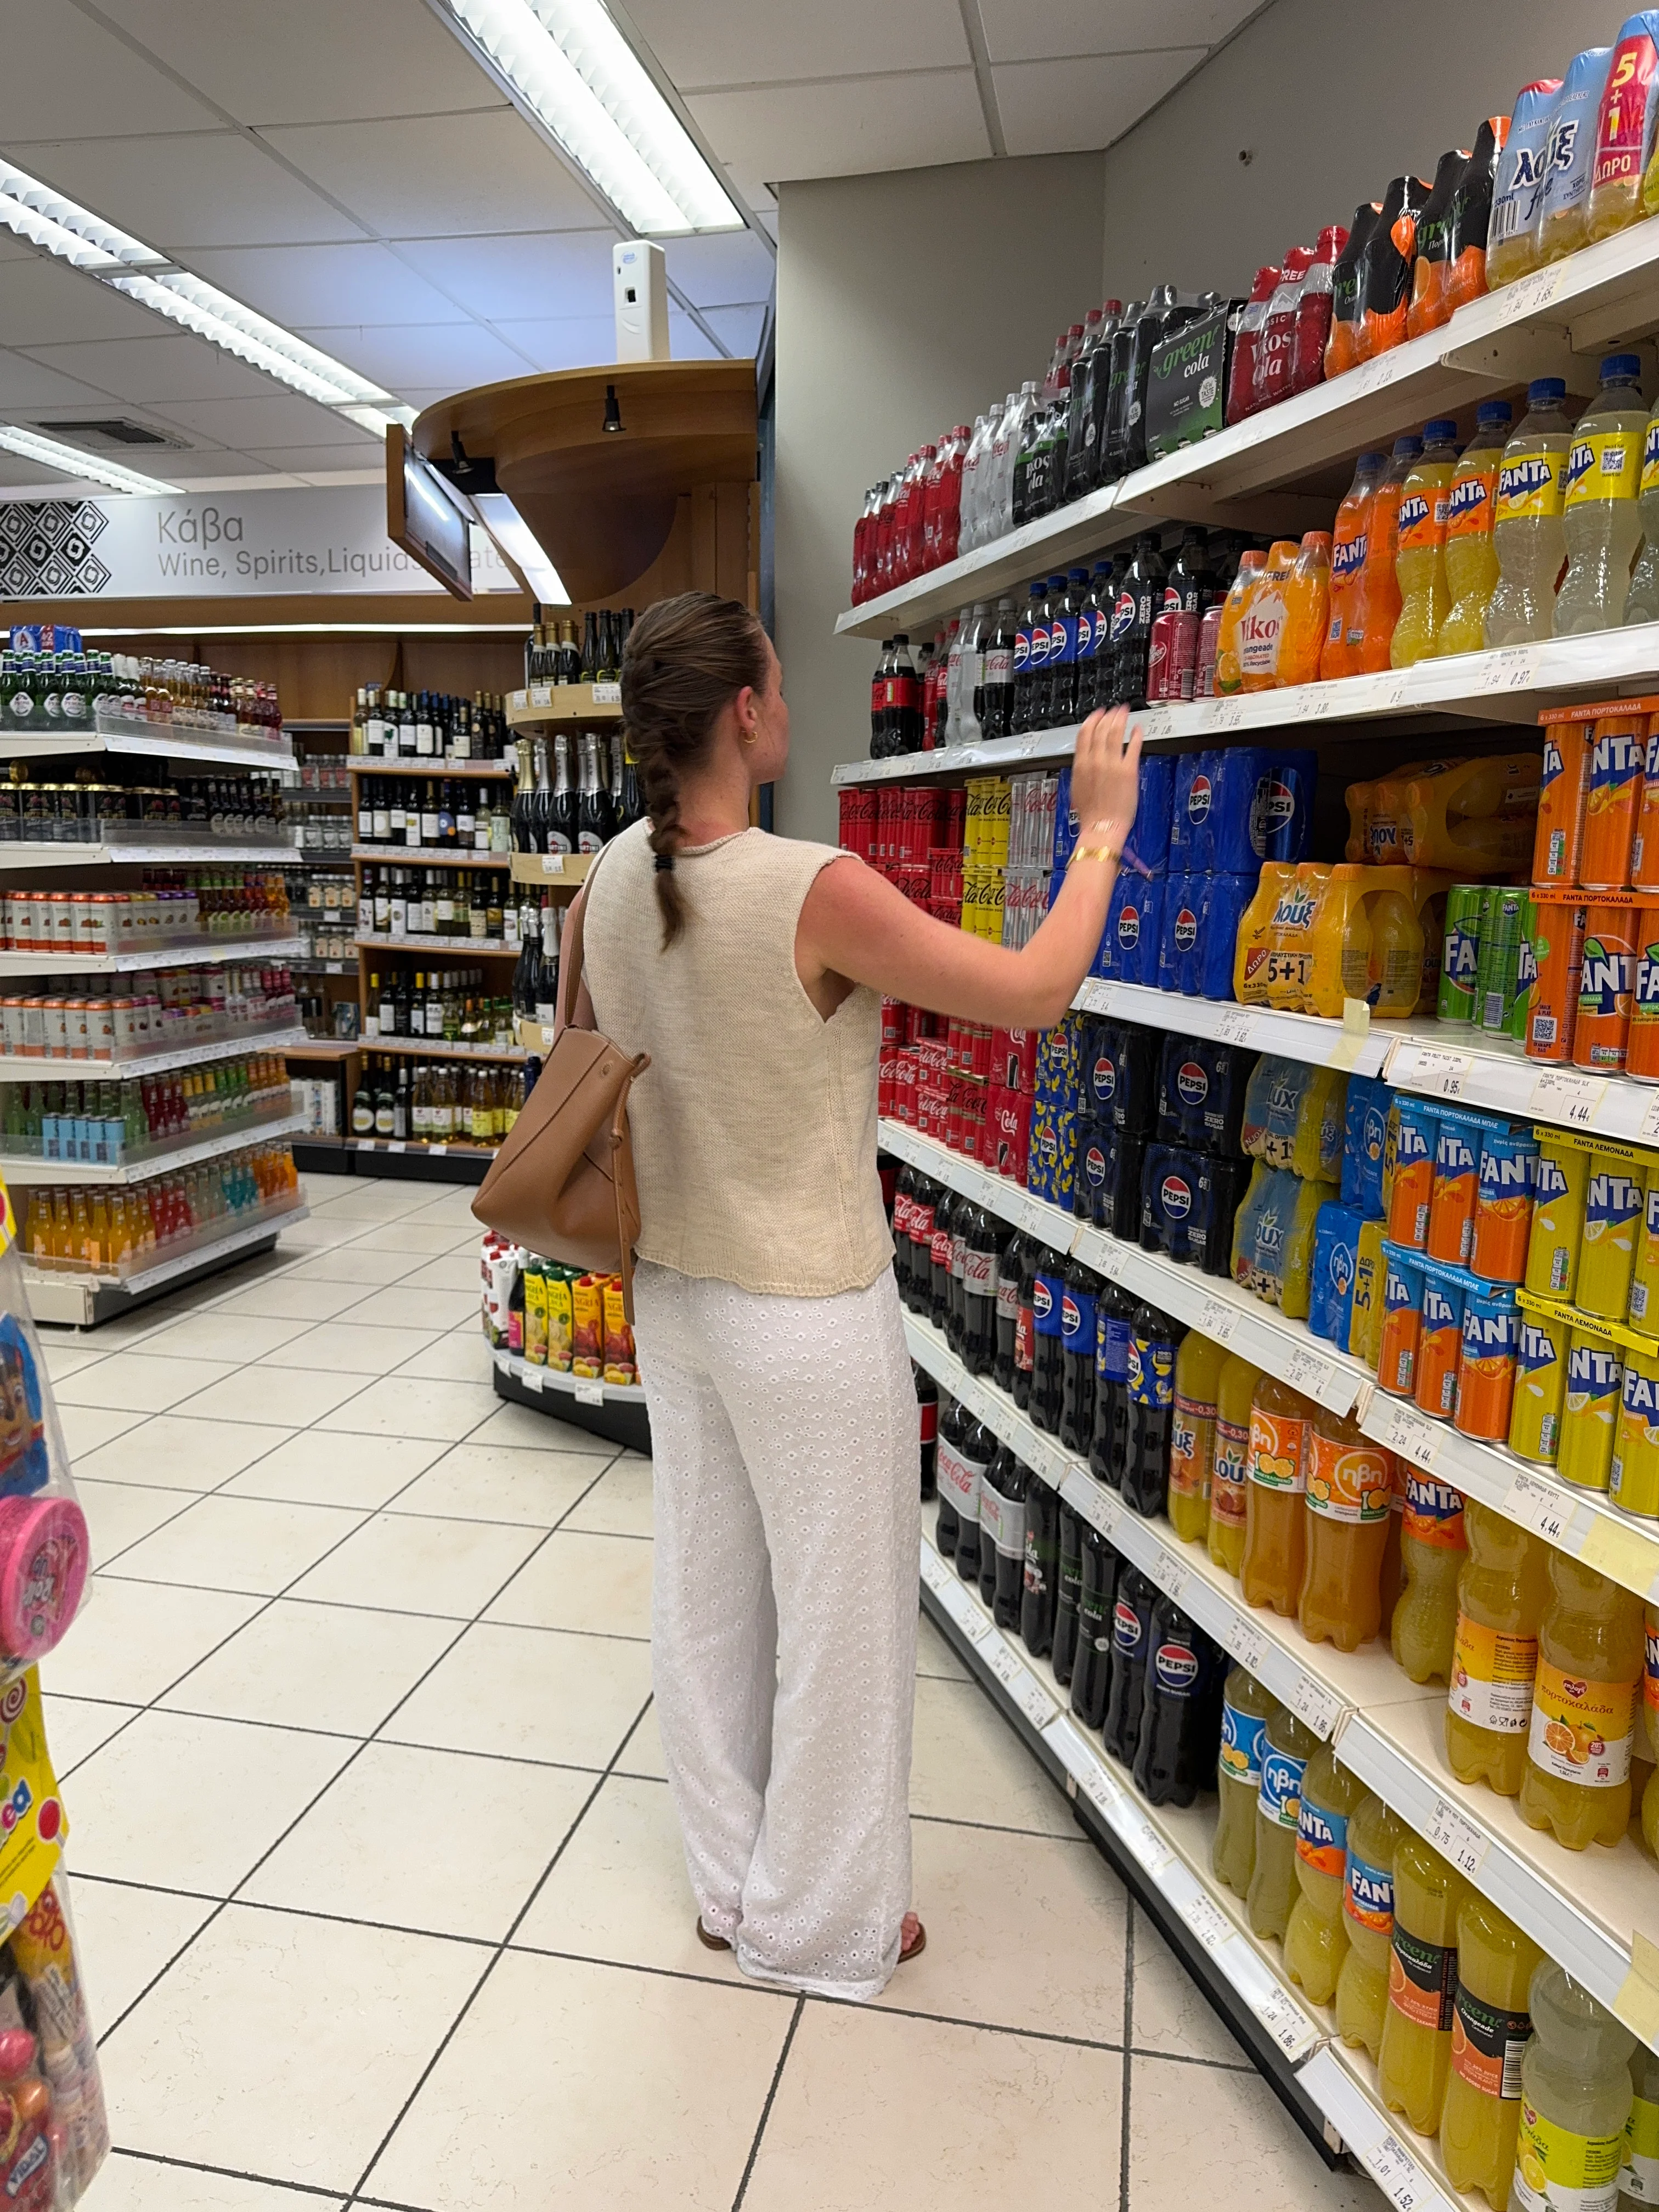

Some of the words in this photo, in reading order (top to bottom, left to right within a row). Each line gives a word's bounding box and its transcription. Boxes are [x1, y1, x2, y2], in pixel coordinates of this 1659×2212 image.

[1612, 52, 1637, 87] 5
[1609, 106, 1621, 142] 1
[1595, 155, 1630, 182] ΔΩΡΟ
[1184, 353, 1209, 378] cola
[1201, 386, 1214, 398] TASTE
[1499, 461, 1551, 492] FANTA
[1450, 479, 1485, 509] ANTA
[1399, 497, 1429, 522] ANTA
[158, 507, 244, 550] Κάβα
[158, 553, 226, 579] Wine,
[1032, 641, 1049, 650] EPSI
[1571, 708, 1590, 718] FANTA
[1592, 703, 1641, 716] ΠΟΡΤΟΚΑΛΑΔΑ
[1592, 736, 1645, 774] NTA
[1190, 795, 1210, 806] PEPSI
[1584, 895, 1633, 904] ΠΟΡΤΟΚΑΛΑΔΑ
[1119, 921, 1138, 934] PEPSI
[1176, 926, 1195, 936] PEPSI
[1248, 949, 1267, 974] ΔΩΡΟ
[1268, 958, 1305, 985] 5+1
[1581, 955, 1637, 992] ANT
[1094, 1074, 1114, 1085] PEPSI
[1180, 1076, 1206, 1091] PEPSI
[1204, 1115, 1224, 1125] ZERO
[1424, 1105, 1439, 1115] FANTA
[1440, 1109, 1481, 1124] ΠΟΡΤΟΚΑΛΑΔΑ
[1482, 1119, 1498, 1129] ΜΠΛΕ
[1574, 1138, 1594, 1148] FANTA
[1595, 1142, 1634, 1158] ΛΕΜΟΝΑΔΑ
[1087, 1160, 1105, 1173] PEPSI
[1481, 1152, 1536, 1185] FANT
[1163, 1192, 1190, 1206] PEPSI
[1590, 1176, 1643, 1210] NTA
[1188, 1229, 1206, 1240] ZERO
[1409, 1258, 1424, 1268] FANTA
[1425, 1263, 1462, 1284] ΠΟΡΤΟΚΑΛΑΔΑ
[1463, 1280, 1479, 1290] ΜΠΛΕ
[1463, 1308, 1522, 1344] FANT
[1554, 1310, 1574, 1322] FANTA
[1575, 1315, 1612, 1337] ΛΕΜΟΝΑΔΑ
[1569, 1348, 1623, 1384] NTA
[1158, 1657, 1196, 1673] PEPSI
[1541, 1685, 1615, 1714] πορτοκαλάδα
[1461, 2007, 1494, 2034] Orangeade
